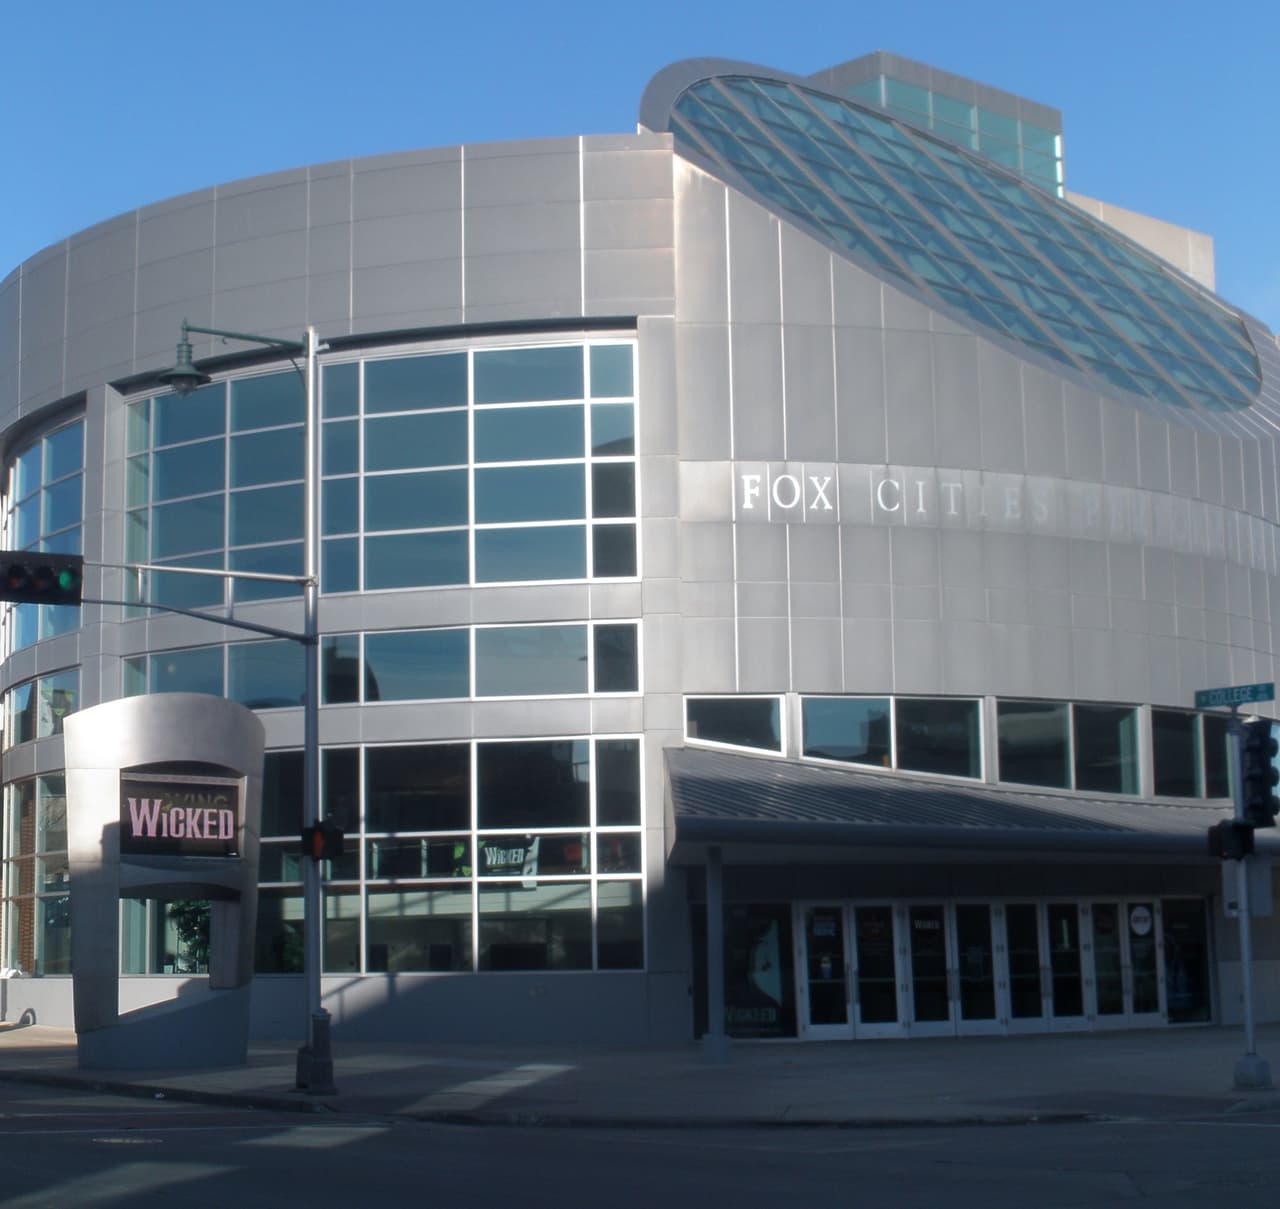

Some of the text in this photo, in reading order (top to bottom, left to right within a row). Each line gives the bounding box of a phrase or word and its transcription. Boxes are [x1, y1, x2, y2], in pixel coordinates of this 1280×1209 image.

[741, 474, 833, 510] FOX
[877, 479, 1049, 523] CITIES
[1209, 686, 1253, 705] COLLEGE
